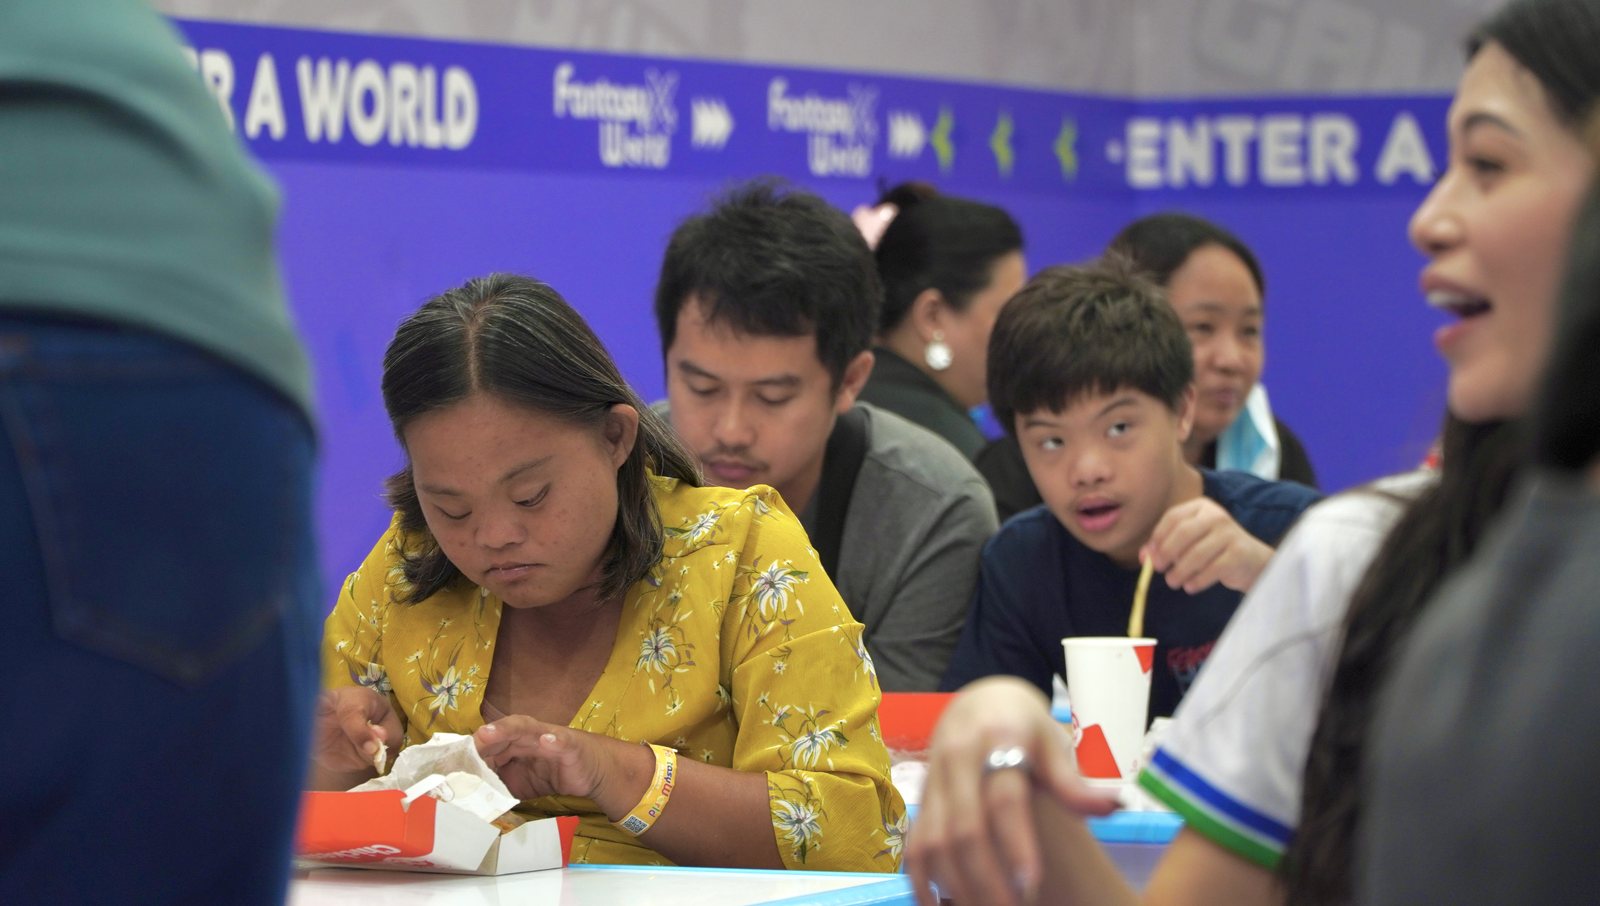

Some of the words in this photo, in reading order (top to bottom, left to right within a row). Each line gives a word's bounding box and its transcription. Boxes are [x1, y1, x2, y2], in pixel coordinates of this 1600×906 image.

[244, 52, 287, 141] A
[296, 56, 479, 150] WORLD
[1125, 113, 1360, 189] ENTER
[1374, 110, 1435, 187] A
